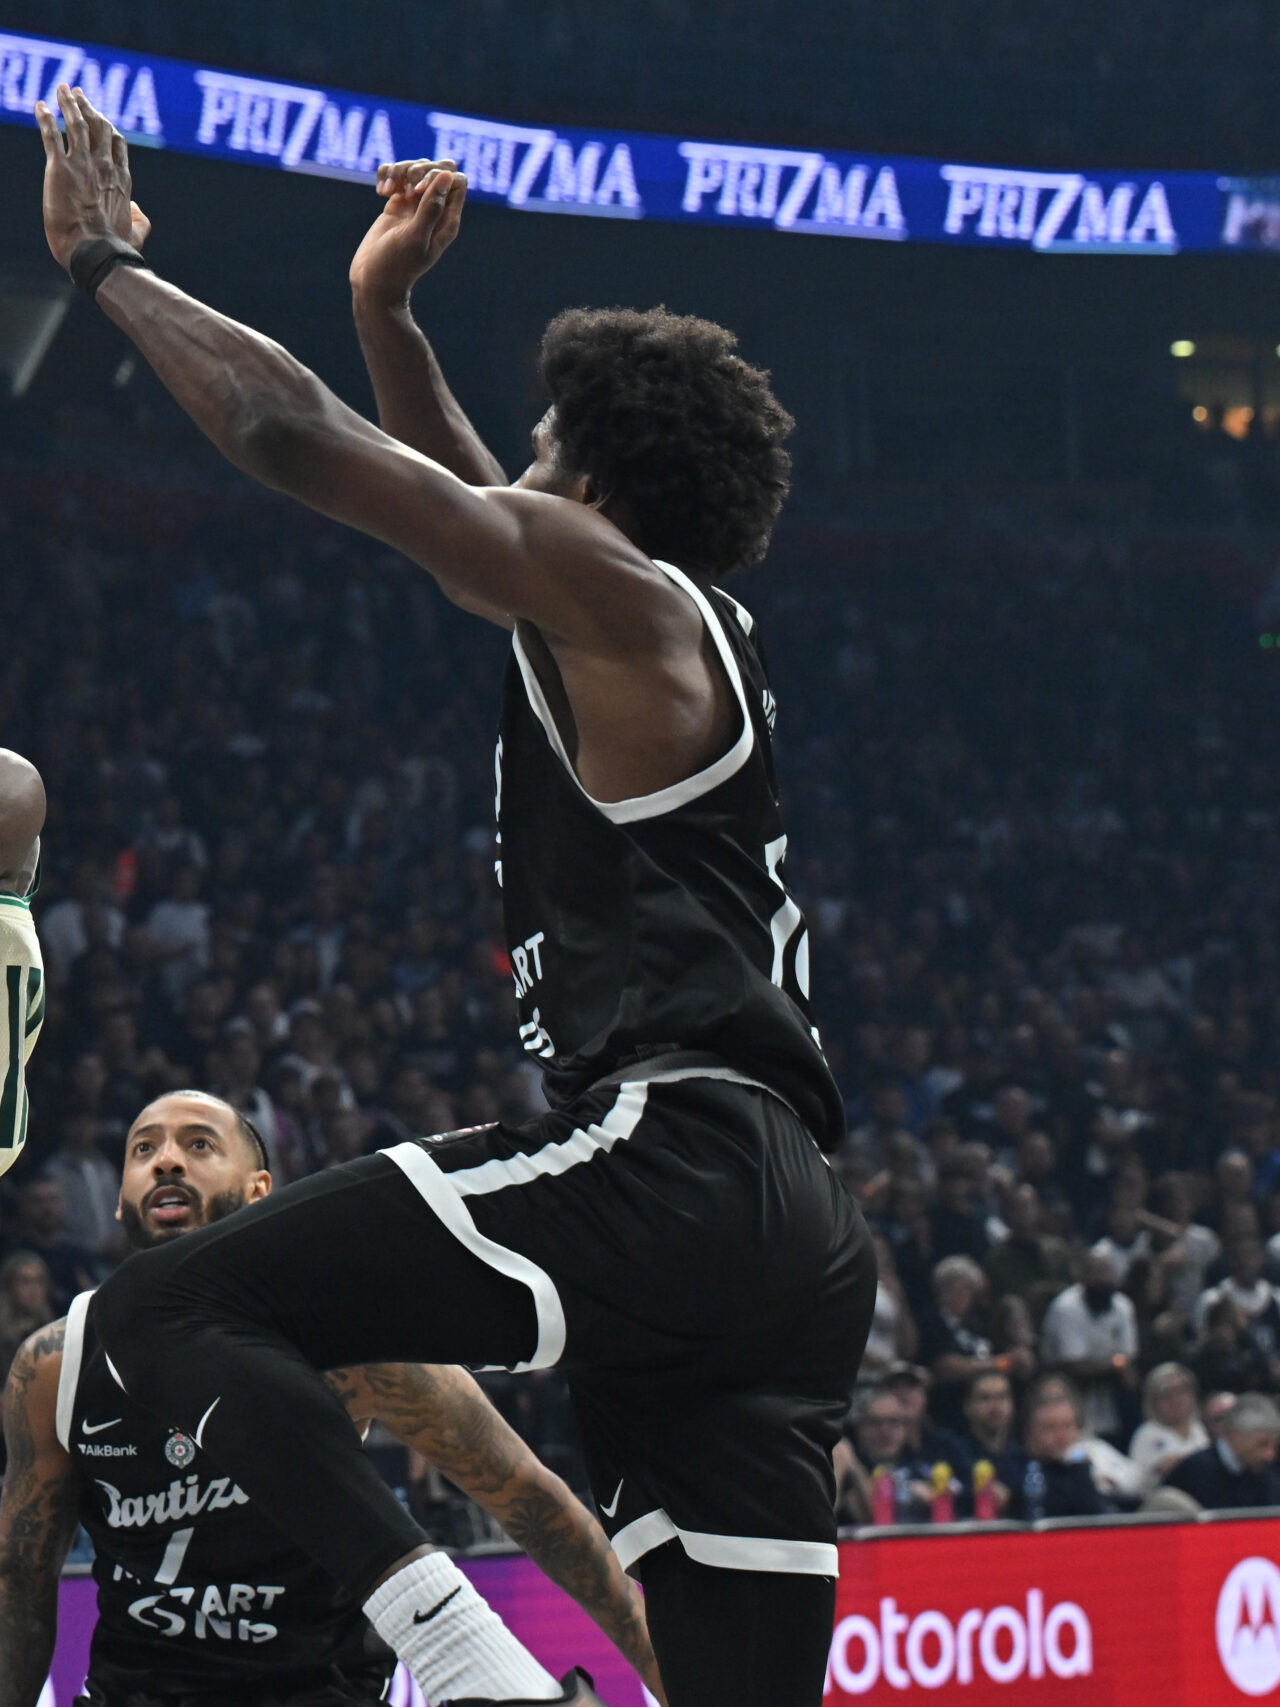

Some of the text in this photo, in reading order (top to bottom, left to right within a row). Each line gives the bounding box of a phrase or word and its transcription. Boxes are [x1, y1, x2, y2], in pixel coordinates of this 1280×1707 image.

[194, 69, 396, 186] PRIZMA
[678, 141, 908, 241] PRIZMA
[939, 164, 1180, 255] PRIZMA
[85, 1443, 138, 1457] AikBank
[822, 1587, 1093, 1696] otorola
